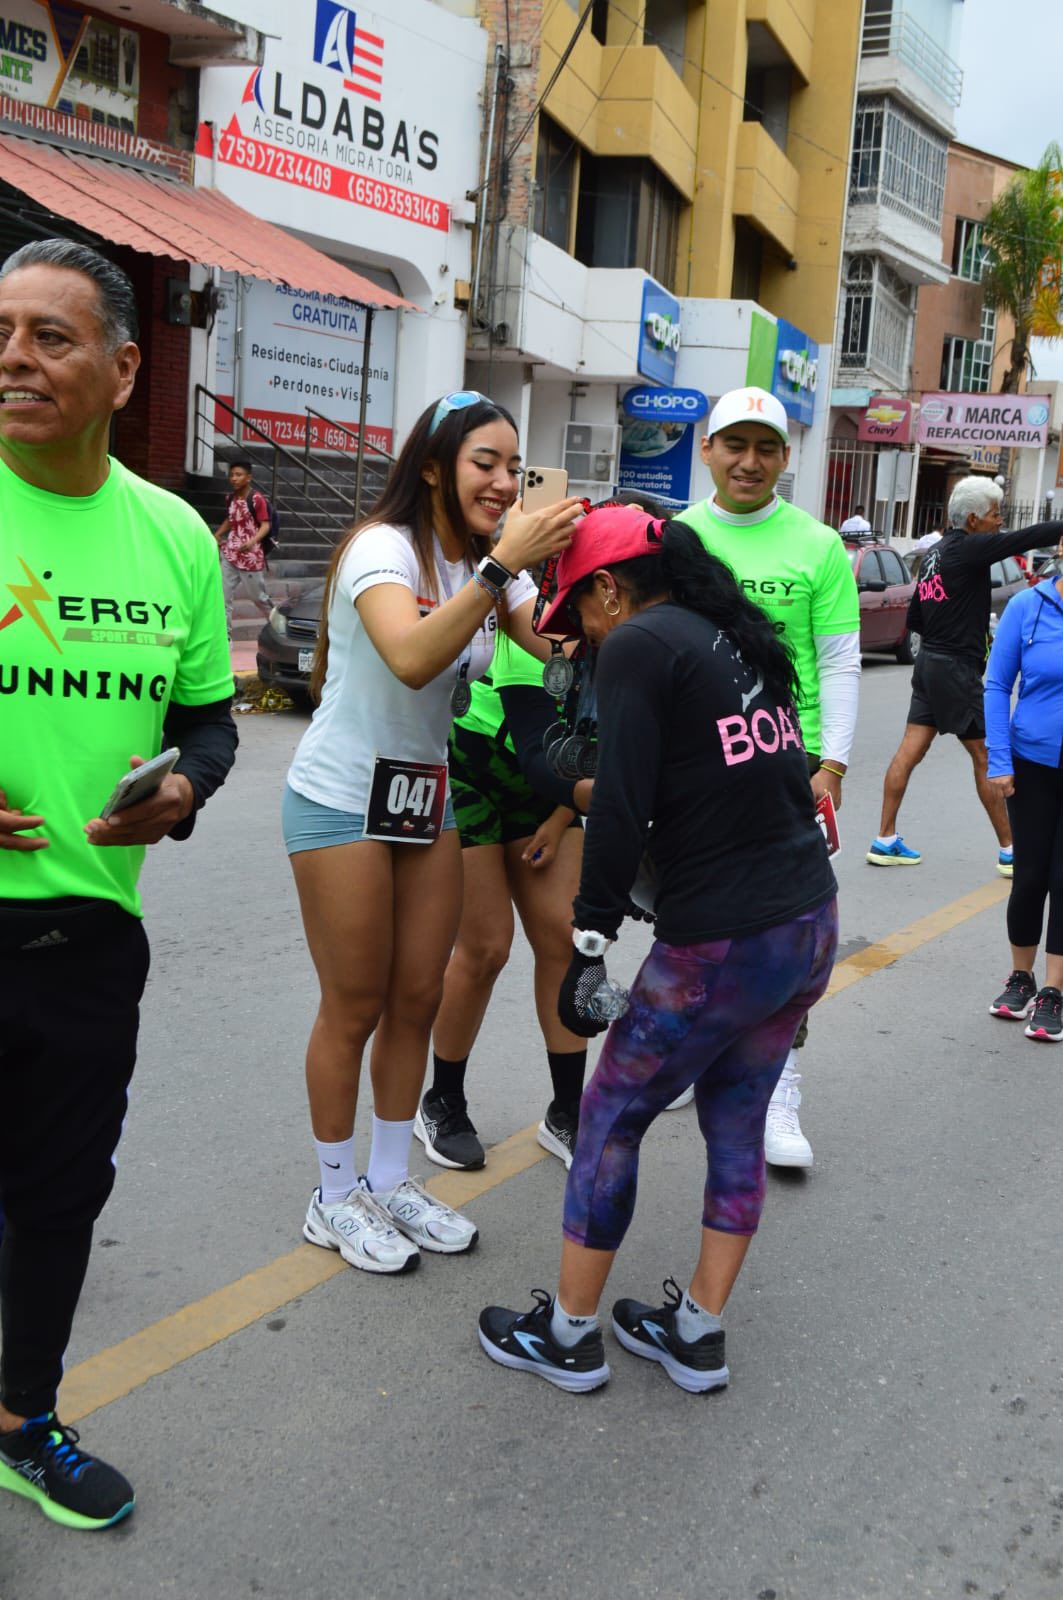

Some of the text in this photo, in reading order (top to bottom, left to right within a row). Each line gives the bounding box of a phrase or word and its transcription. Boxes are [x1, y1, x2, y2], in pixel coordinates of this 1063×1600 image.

[253, 115, 413, 186] ASESORIA MIGRATORIA
[292, 303, 358, 333] GRATUITA
[252, 344, 322, 369] Residencias
[273, 376, 372, 403] Perdones Viss
[631, 394, 699, 410] CHOPO
[965, 407, 1023, 425] MARCA
[868, 425, 898, 437] Chevy
[926, 426, 1041, 442] REFACCIONARIA
[623, 479, 672, 490] laboratorio
[387, 774, 438, 817] 047
